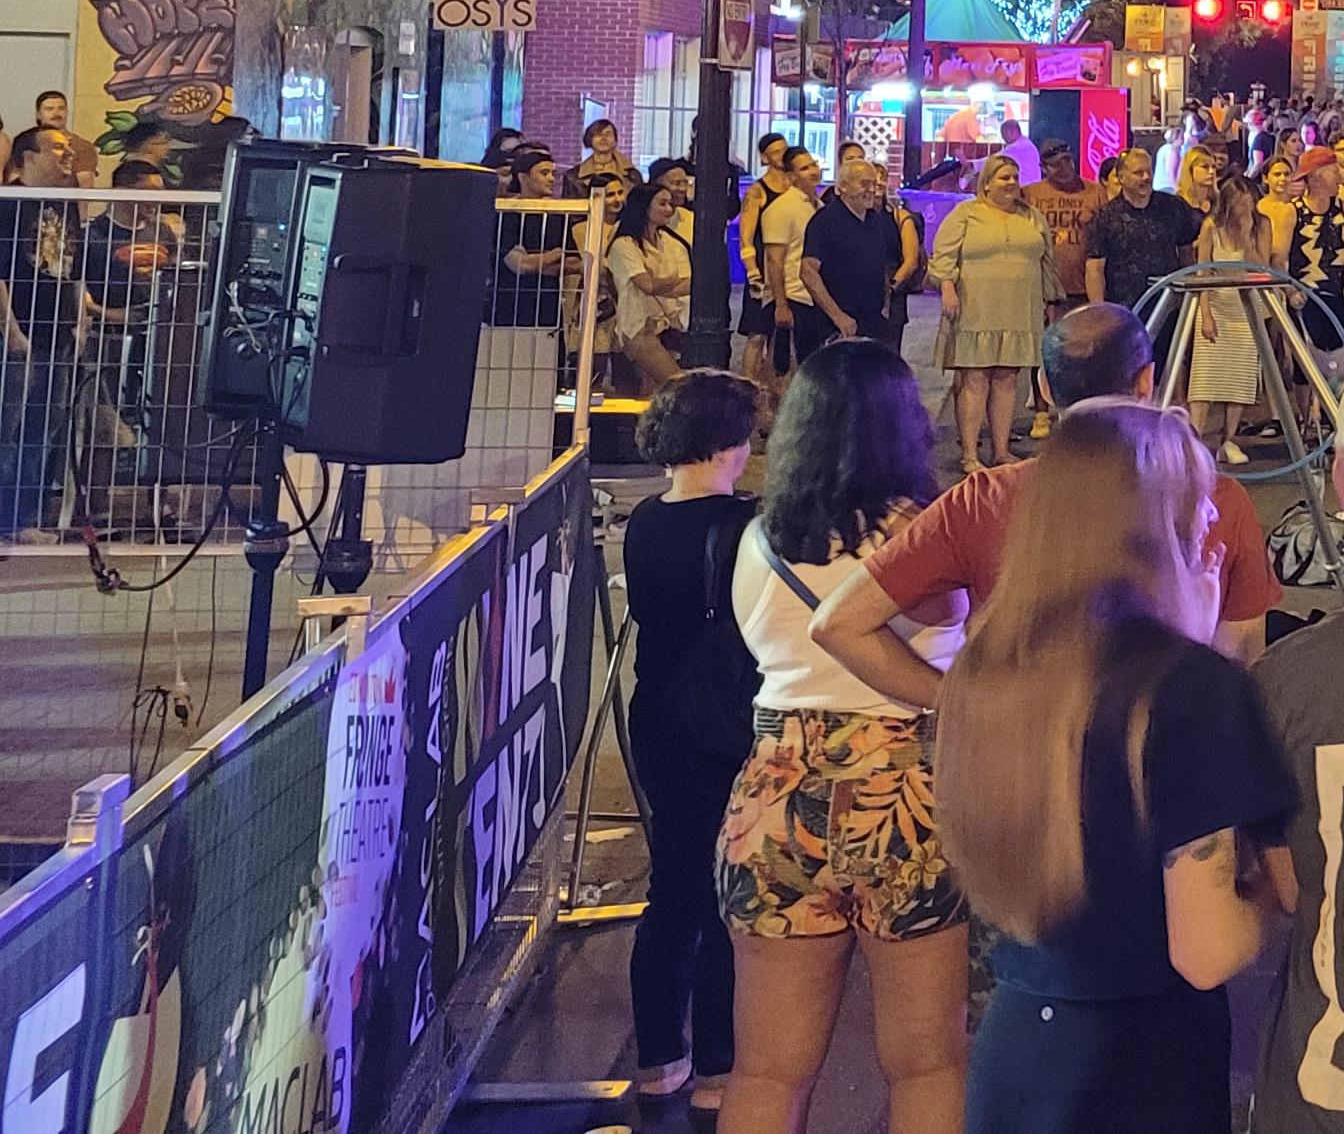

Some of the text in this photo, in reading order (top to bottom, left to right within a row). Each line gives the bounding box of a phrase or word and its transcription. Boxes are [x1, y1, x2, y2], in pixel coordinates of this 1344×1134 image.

[1041, 210, 1083, 228] OCK
[1058, 197, 1085, 210] ONLY
[342, 714, 397, 790] FRINGE
[335, 797, 390, 866] THEATRE
